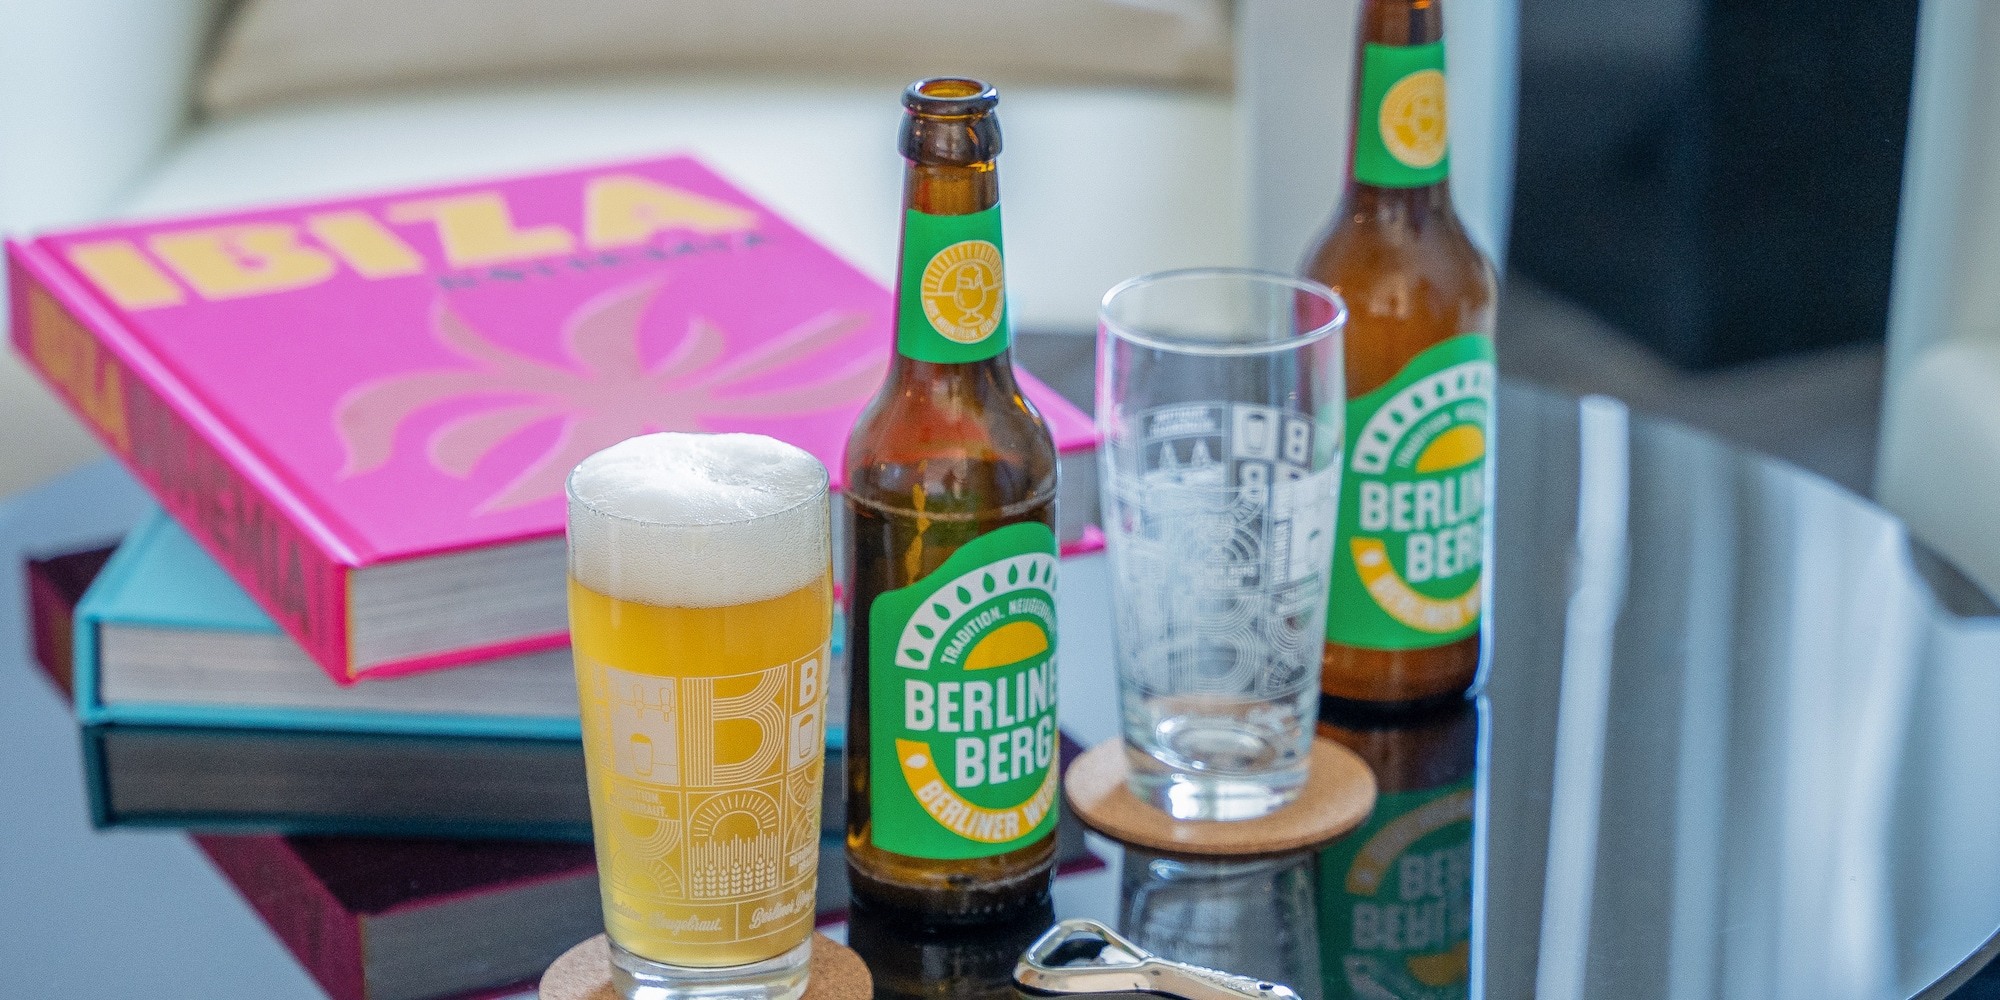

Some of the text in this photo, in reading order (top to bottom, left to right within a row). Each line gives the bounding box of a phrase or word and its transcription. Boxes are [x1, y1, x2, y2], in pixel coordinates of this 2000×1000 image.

[67, 175, 760, 312] IBIZA
[940, 606, 1006, 665] TRADITION.
[799, 658, 819, 708] B
[904, 657, 1057, 734] BERLINE
[954, 714, 1053, 788] BERG
[916, 779, 1020, 840] BERLINER
